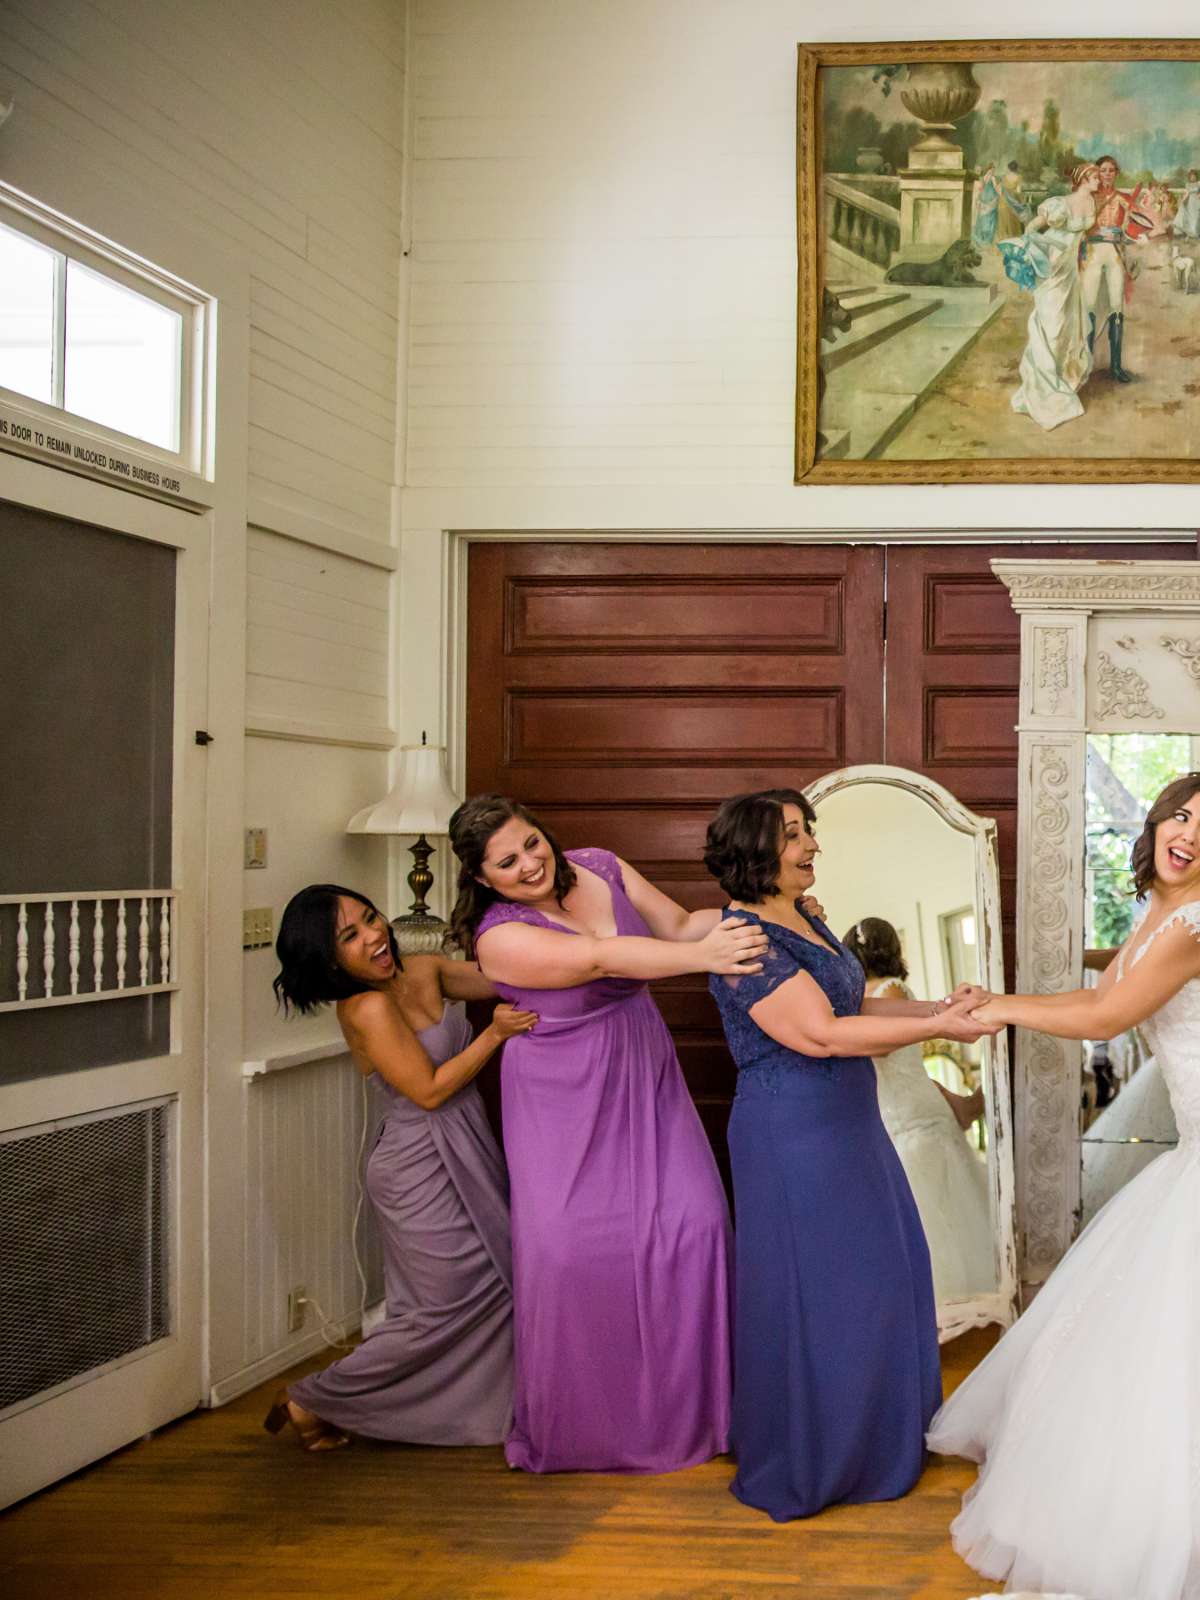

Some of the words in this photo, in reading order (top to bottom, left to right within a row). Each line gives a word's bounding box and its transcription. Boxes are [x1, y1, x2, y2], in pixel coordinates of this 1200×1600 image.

[11, 423, 32, 442] DOOR
[34, 431, 44, 446] TO
[46, 436, 71, 455] REMAIN
[74, 447, 107, 468] UNLOCKED
[109, 458, 130, 477] DURING
[132, 466, 160, 486] BUSINESS
[162, 477, 180, 493] HOURS
